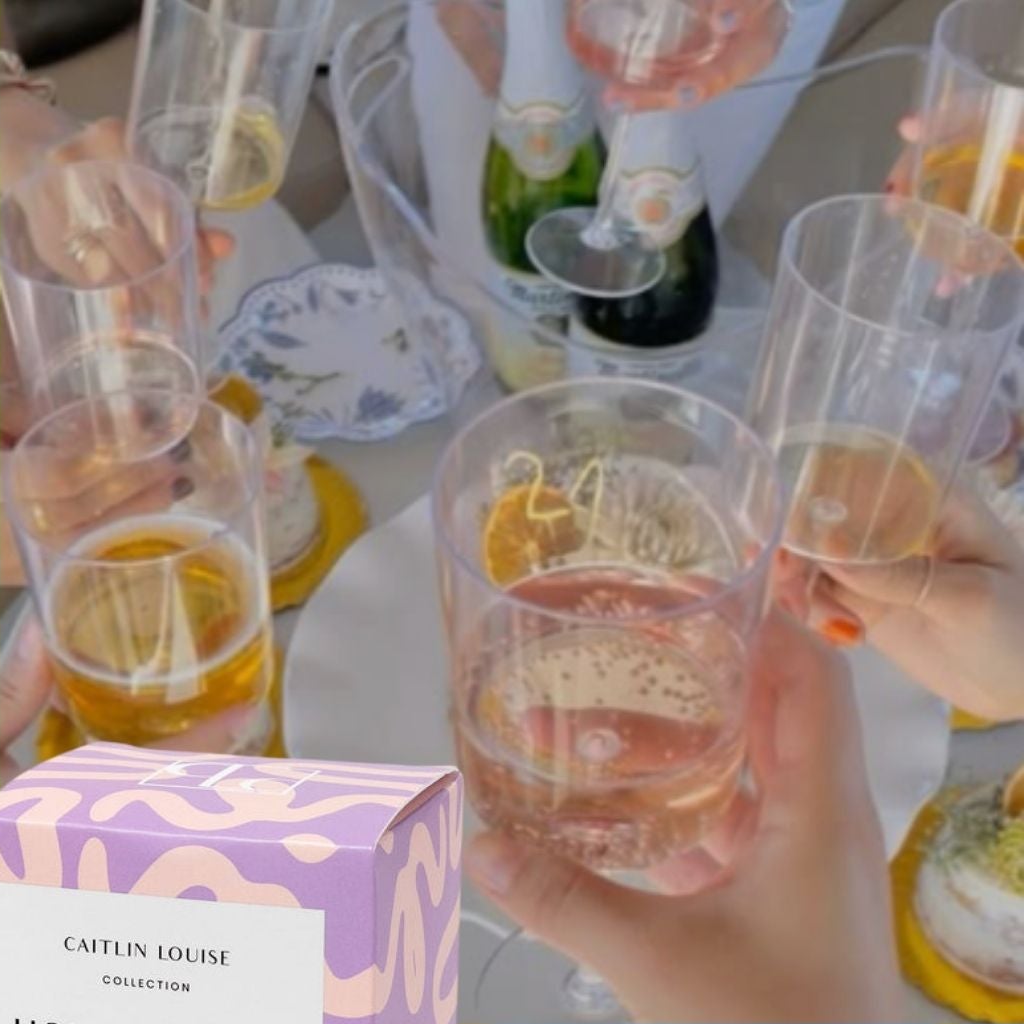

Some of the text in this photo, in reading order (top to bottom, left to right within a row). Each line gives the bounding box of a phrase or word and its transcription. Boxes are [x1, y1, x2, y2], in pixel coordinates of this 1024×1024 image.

[63, 936, 230, 966] CAITLIN LOUISE
[102, 974, 191, 993] COLLECTION
